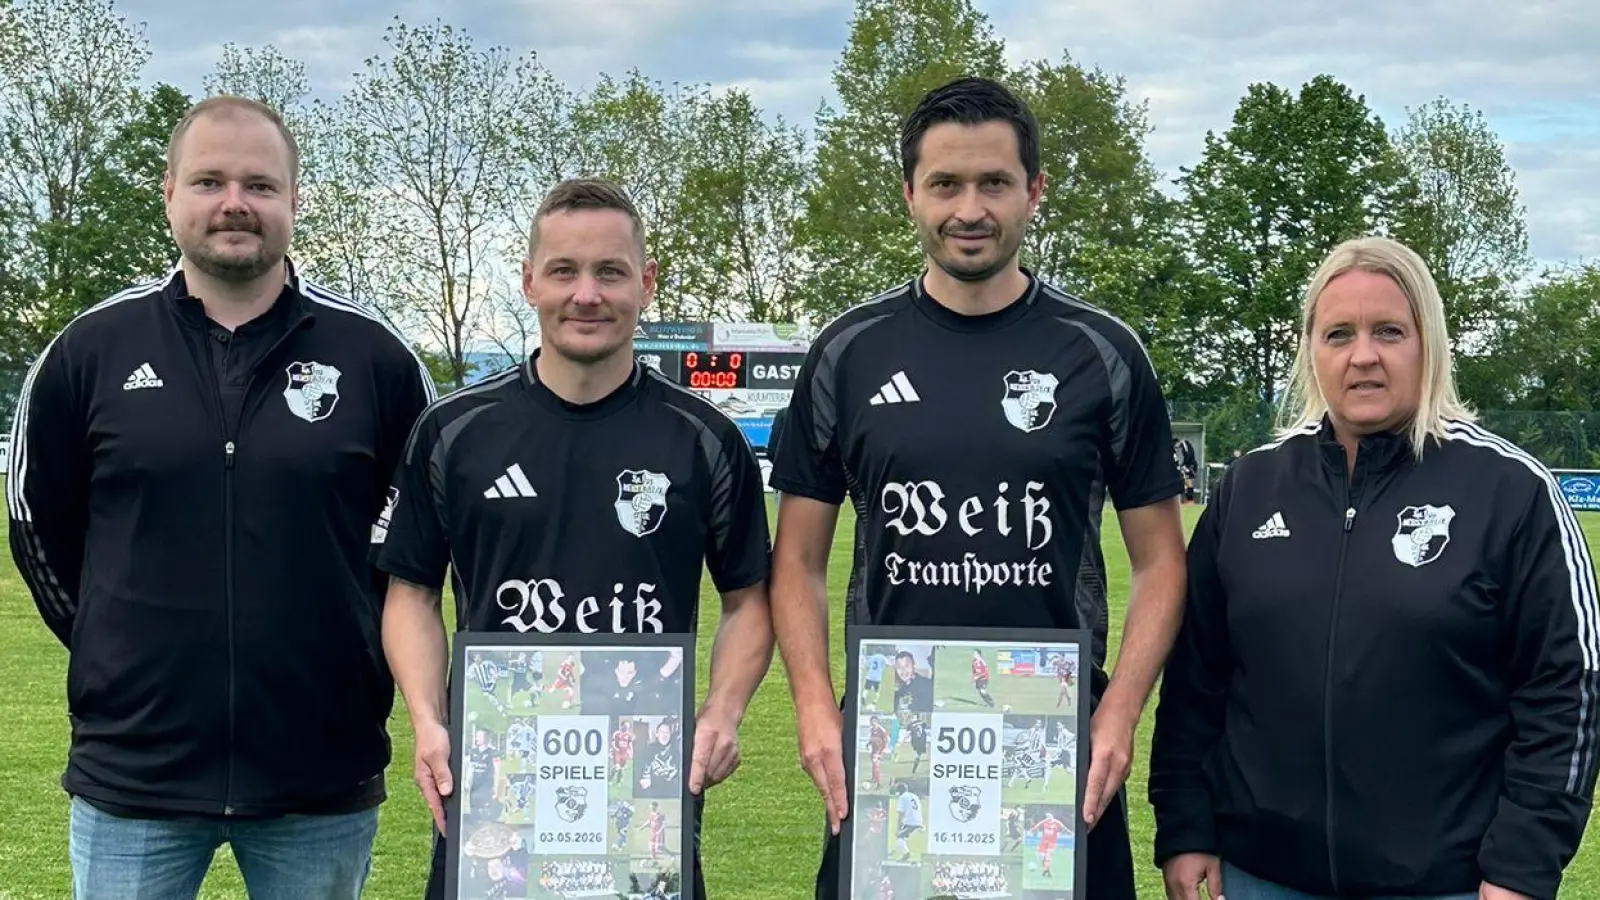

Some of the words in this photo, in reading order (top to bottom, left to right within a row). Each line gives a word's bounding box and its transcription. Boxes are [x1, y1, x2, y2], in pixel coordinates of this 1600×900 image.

[686, 352, 698, 368] 0
[729, 353, 742, 369] 0
[690, 371, 737, 387] 00:00
[752, 364, 802, 380] GAST
[123, 379, 163, 390] adidas
[881, 480, 1053, 550] Weiß
[1251, 529, 1291, 539] adidas
[543, 728, 602, 756] 600
[936, 727, 997, 755] 500
[540, 765, 605, 780] SPIELE
[933, 764, 999, 779] SPIELE
[540, 832, 603, 843] 03.05.2026
[934, 832, 996, 843] 16.11.2025
